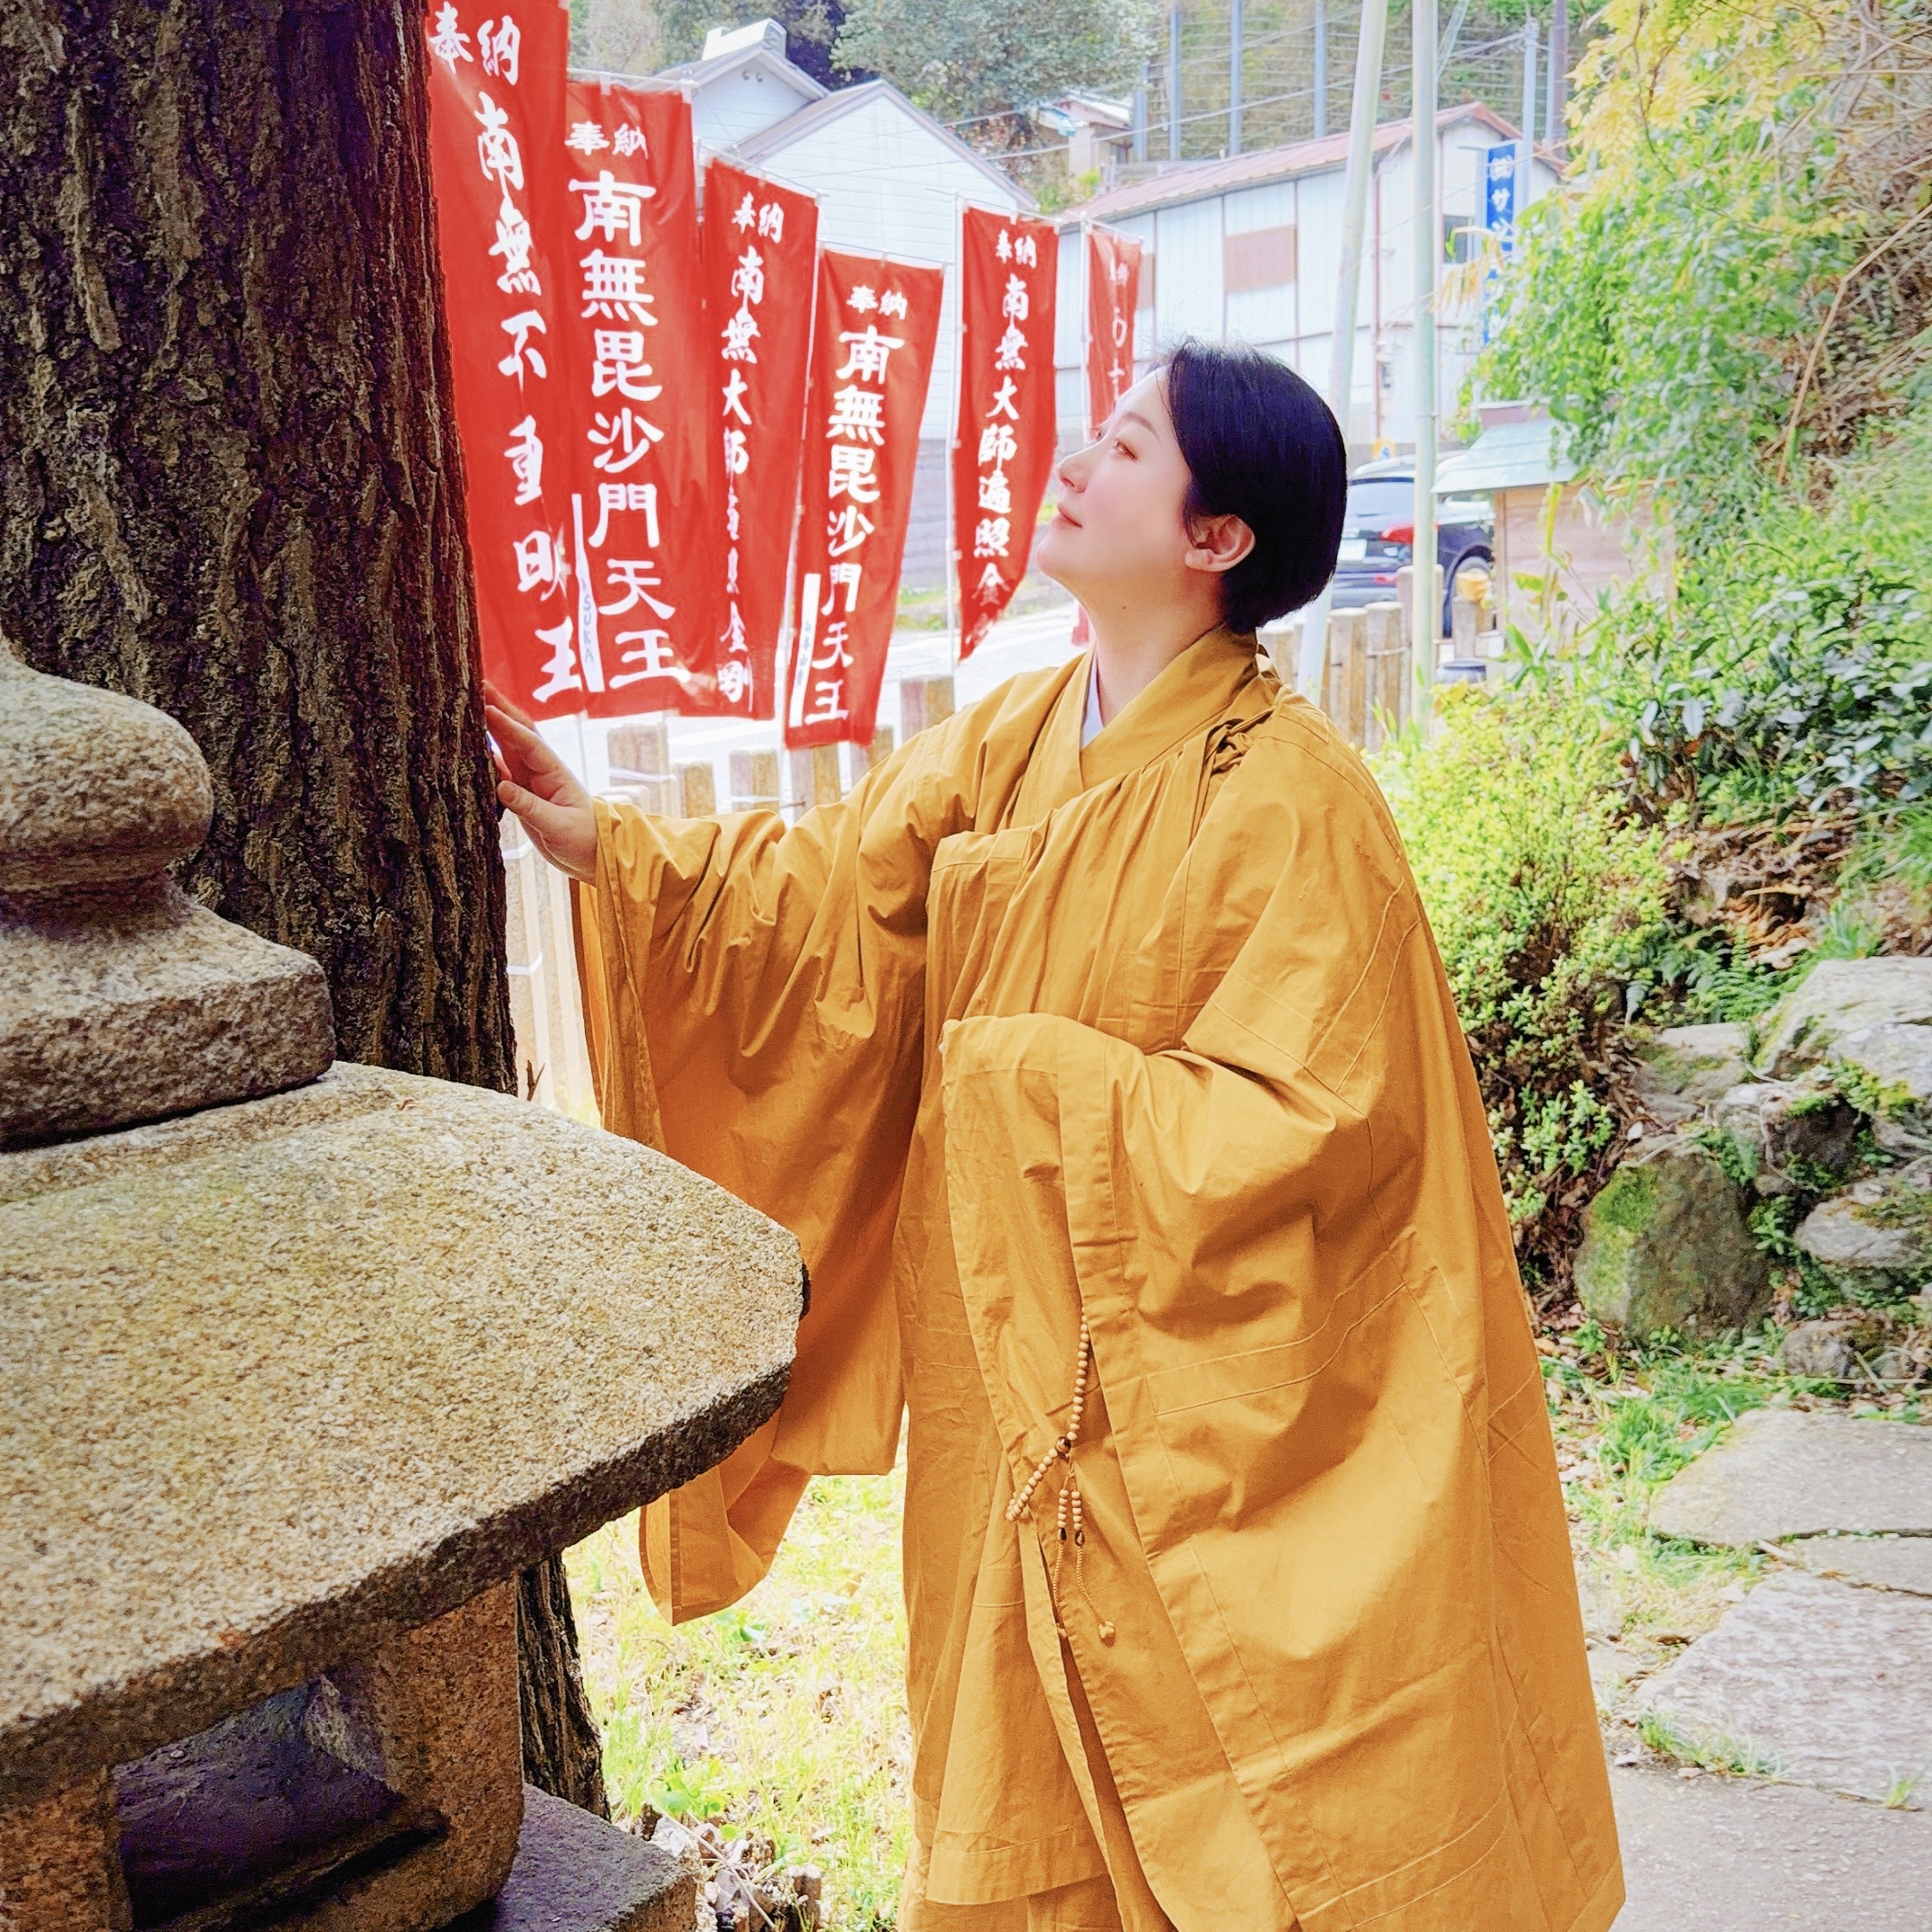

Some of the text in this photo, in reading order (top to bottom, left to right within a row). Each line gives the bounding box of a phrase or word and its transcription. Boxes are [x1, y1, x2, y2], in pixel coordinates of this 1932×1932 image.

[429, 2, 521, 86] 奉納
[564, 122, 649, 159] 奉納
[731, 191, 784, 243] 奉納
[995, 229, 1038, 268] 奉納
[846, 284, 908, 320] 奉納
[568, 170, 691, 690] 南無毘沙門天王
[804, 325, 905, 724] 南無毘沙門天王
